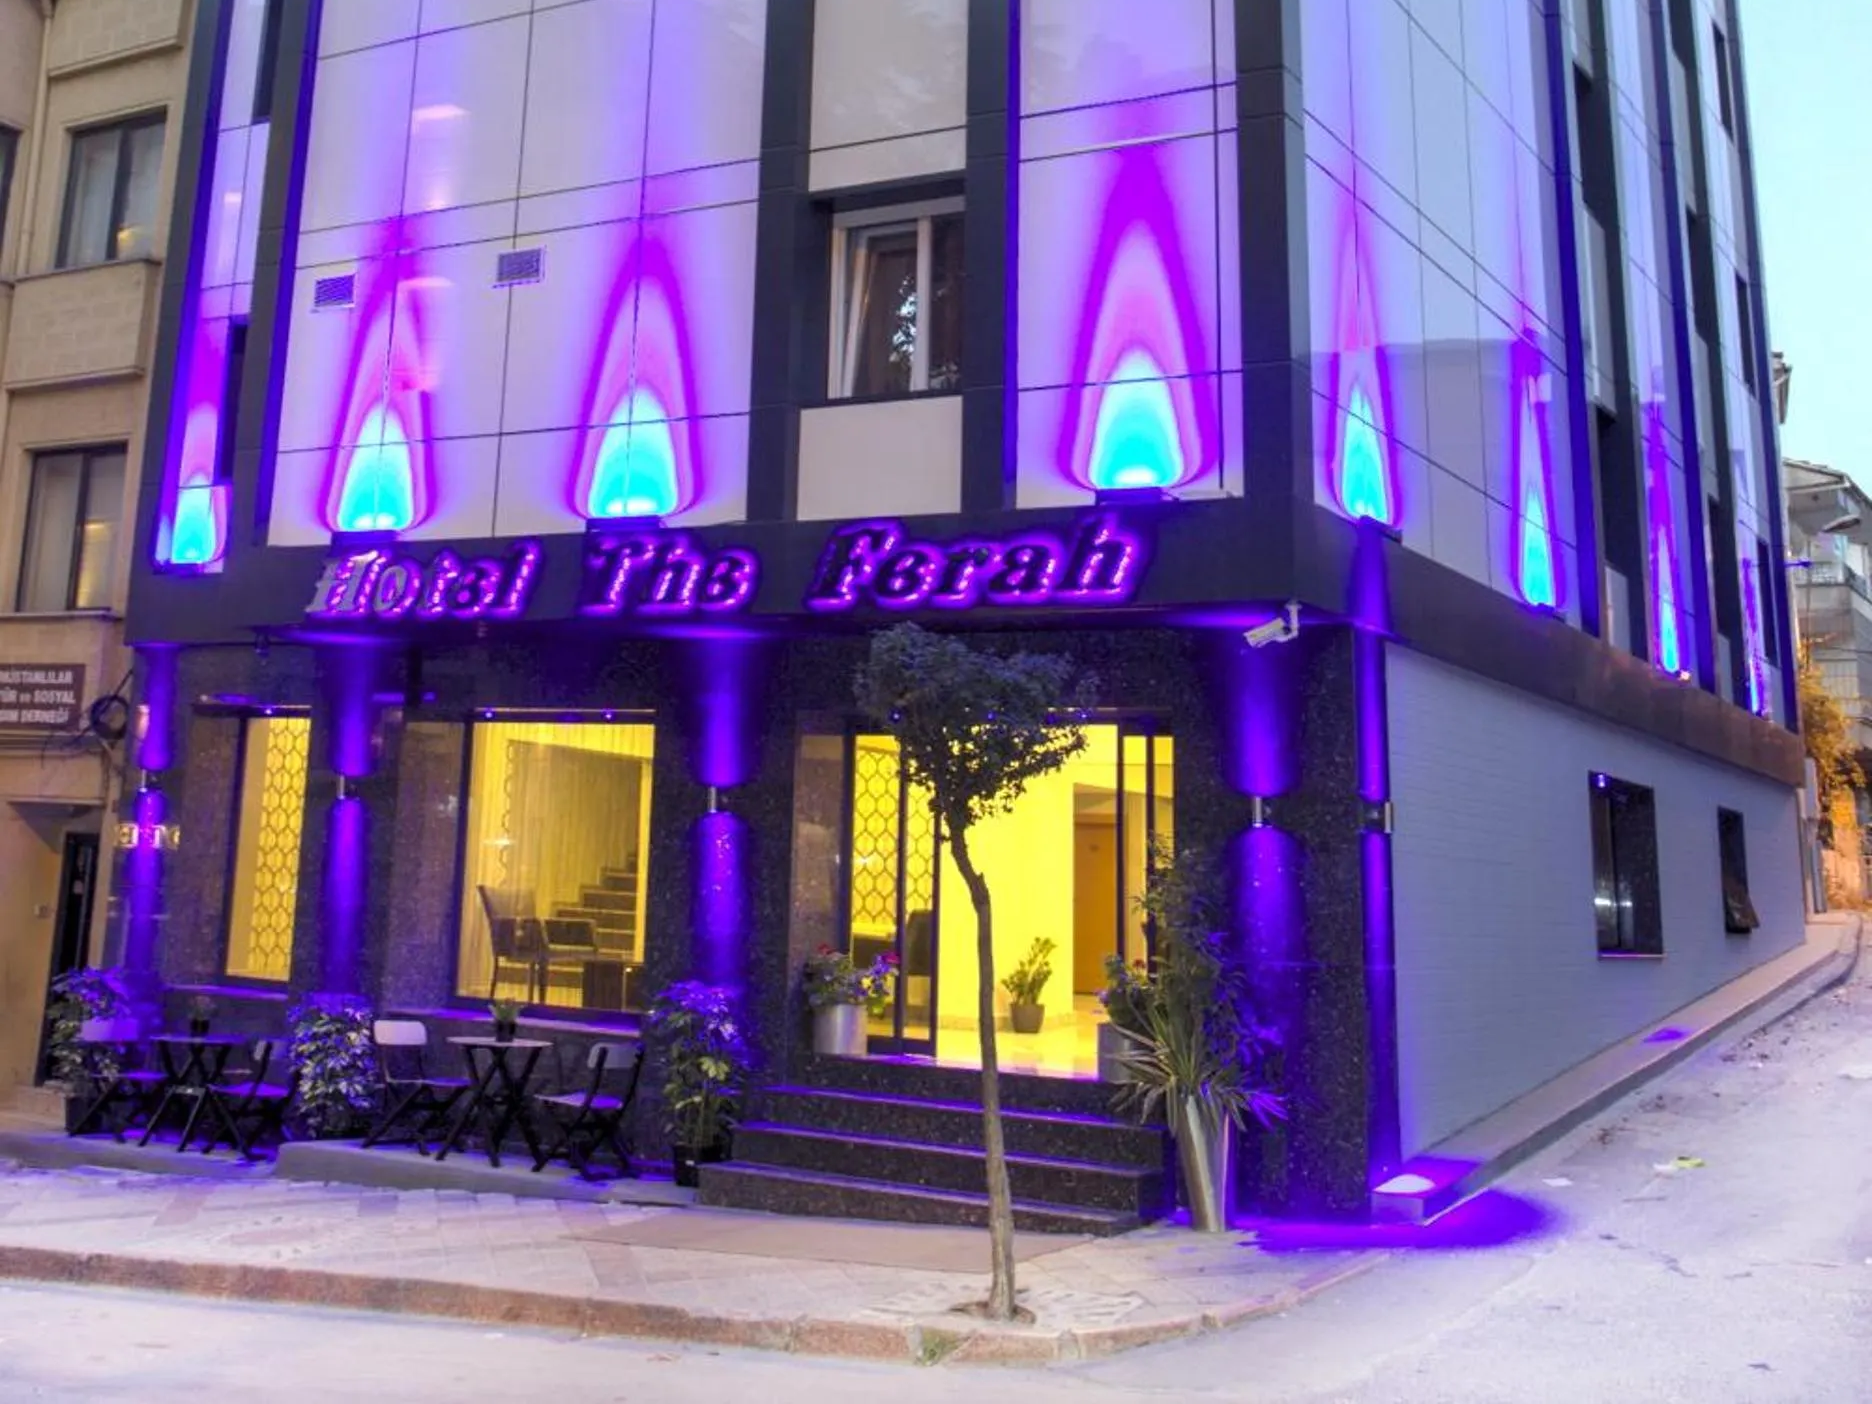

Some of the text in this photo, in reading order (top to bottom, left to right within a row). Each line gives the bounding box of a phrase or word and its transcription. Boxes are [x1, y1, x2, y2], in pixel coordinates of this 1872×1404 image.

[304, 521, 1138, 618] Hotel The Ferah
[34, 689, 76, 704] SOSYAL
